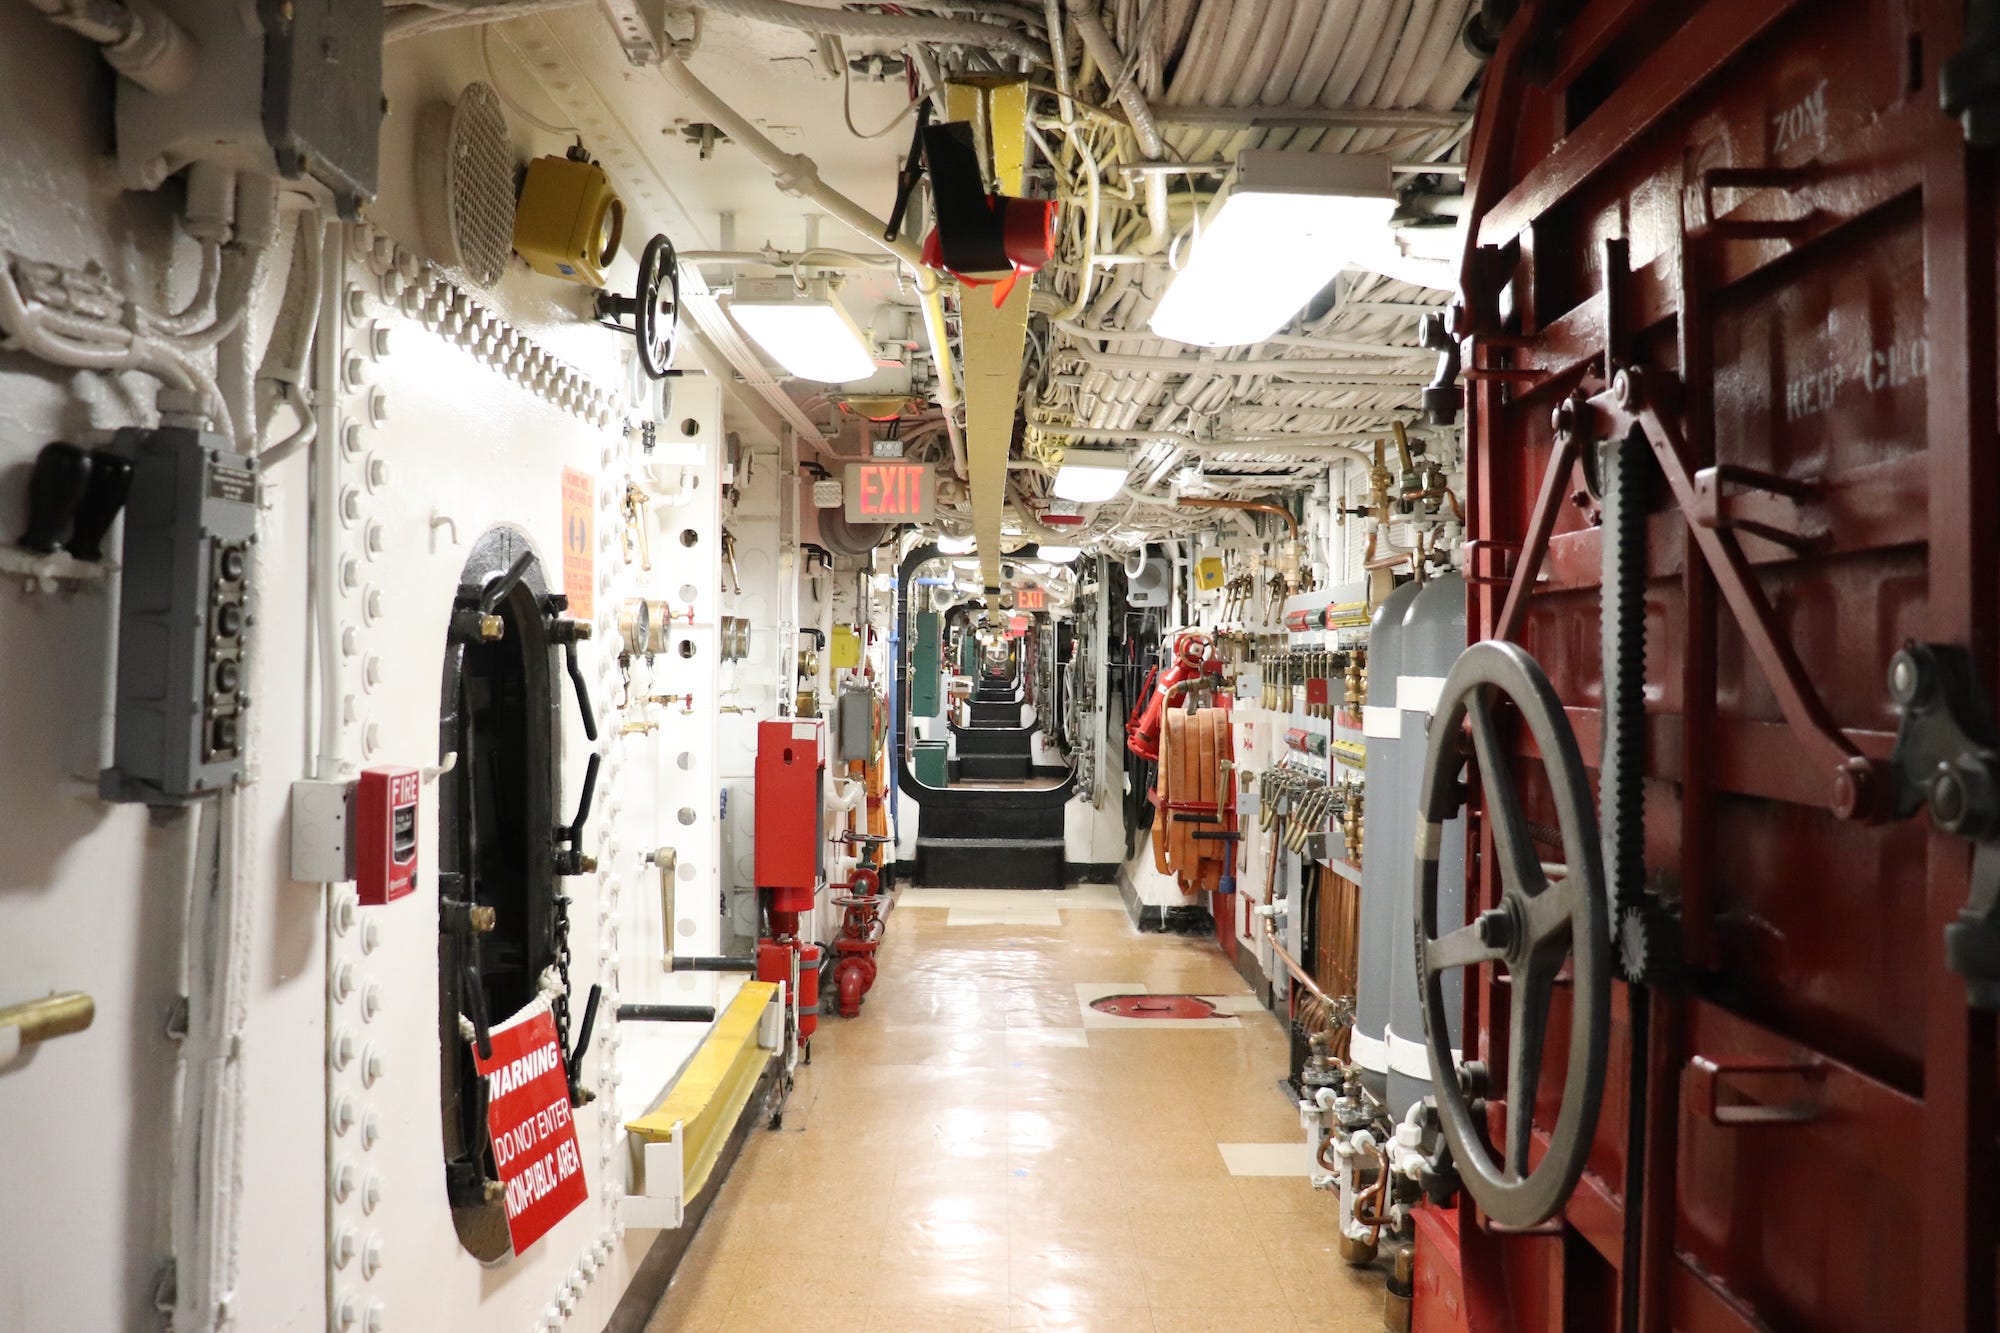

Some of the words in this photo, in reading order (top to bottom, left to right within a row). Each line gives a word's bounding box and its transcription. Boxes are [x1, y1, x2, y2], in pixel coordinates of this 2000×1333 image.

[1786, 363, 1844, 422] KEEP
[861, 466, 925, 514] EXIT
[1018, 590, 1043, 608] EXIT
[391, 774, 418, 804] FIRE
[488, 1041, 558, 1103] WARNING
[495, 1132, 515, 1167] DO
[513, 1116, 538, 1155] NOT
[536, 1097, 571, 1139] ENTER
[505, 1152, 558, 1220] NON-PUBLIC
[556, 1137, 581, 1182] AREA
